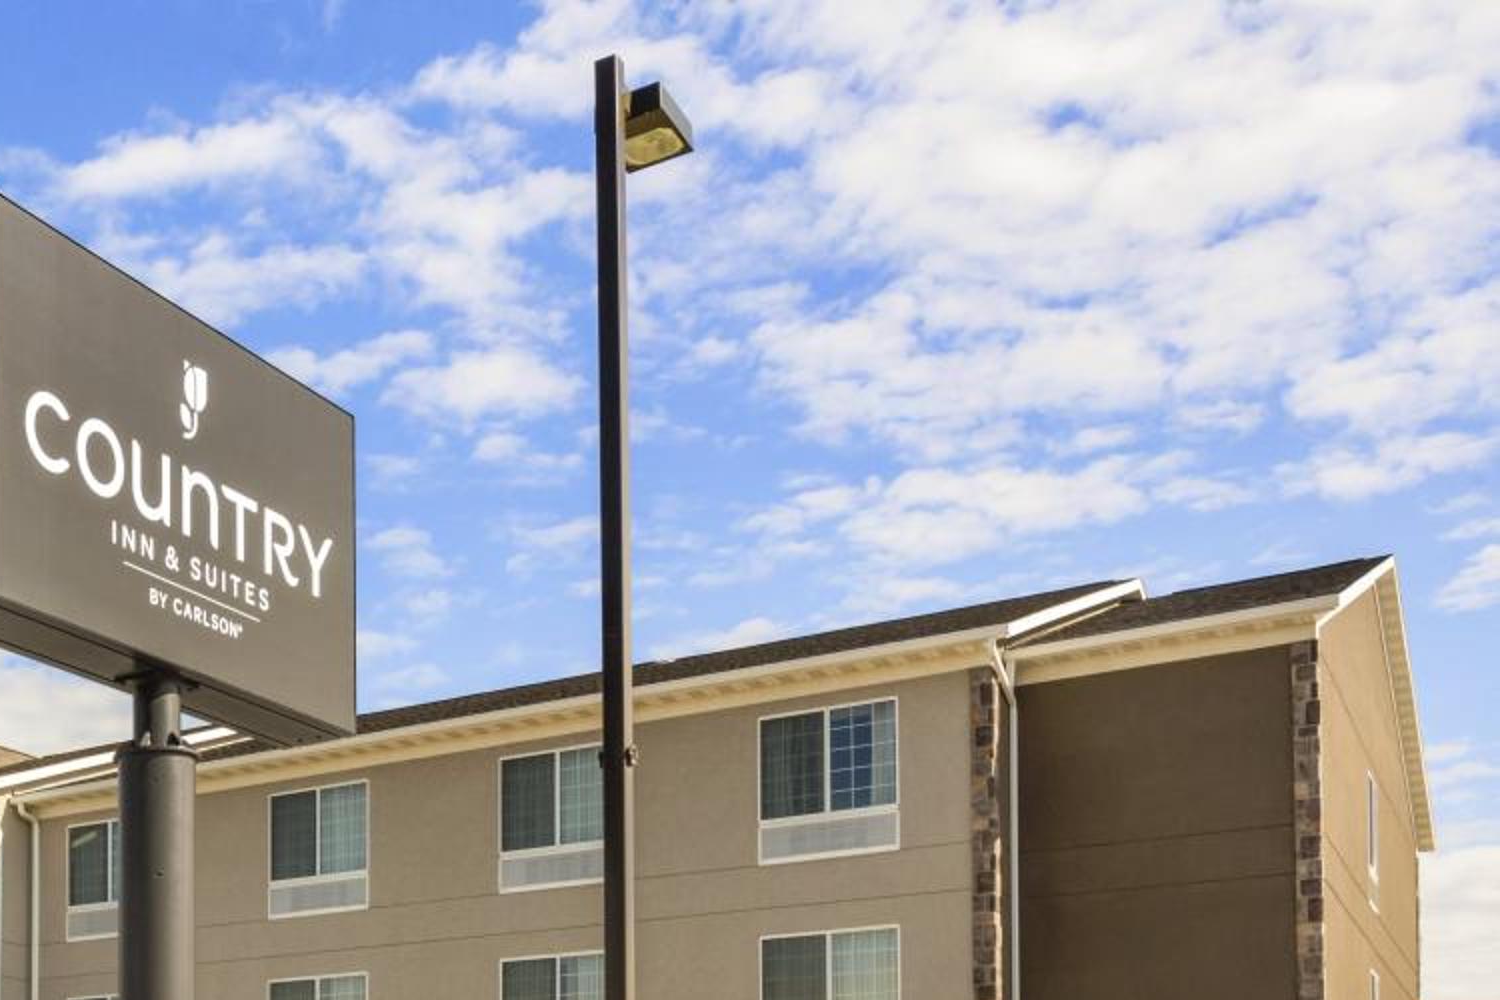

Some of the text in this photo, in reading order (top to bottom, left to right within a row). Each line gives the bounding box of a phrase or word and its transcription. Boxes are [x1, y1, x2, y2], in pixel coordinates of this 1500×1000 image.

[111, 519, 270, 612] INN & SUITES
[149, 587, 169, 609] BY
